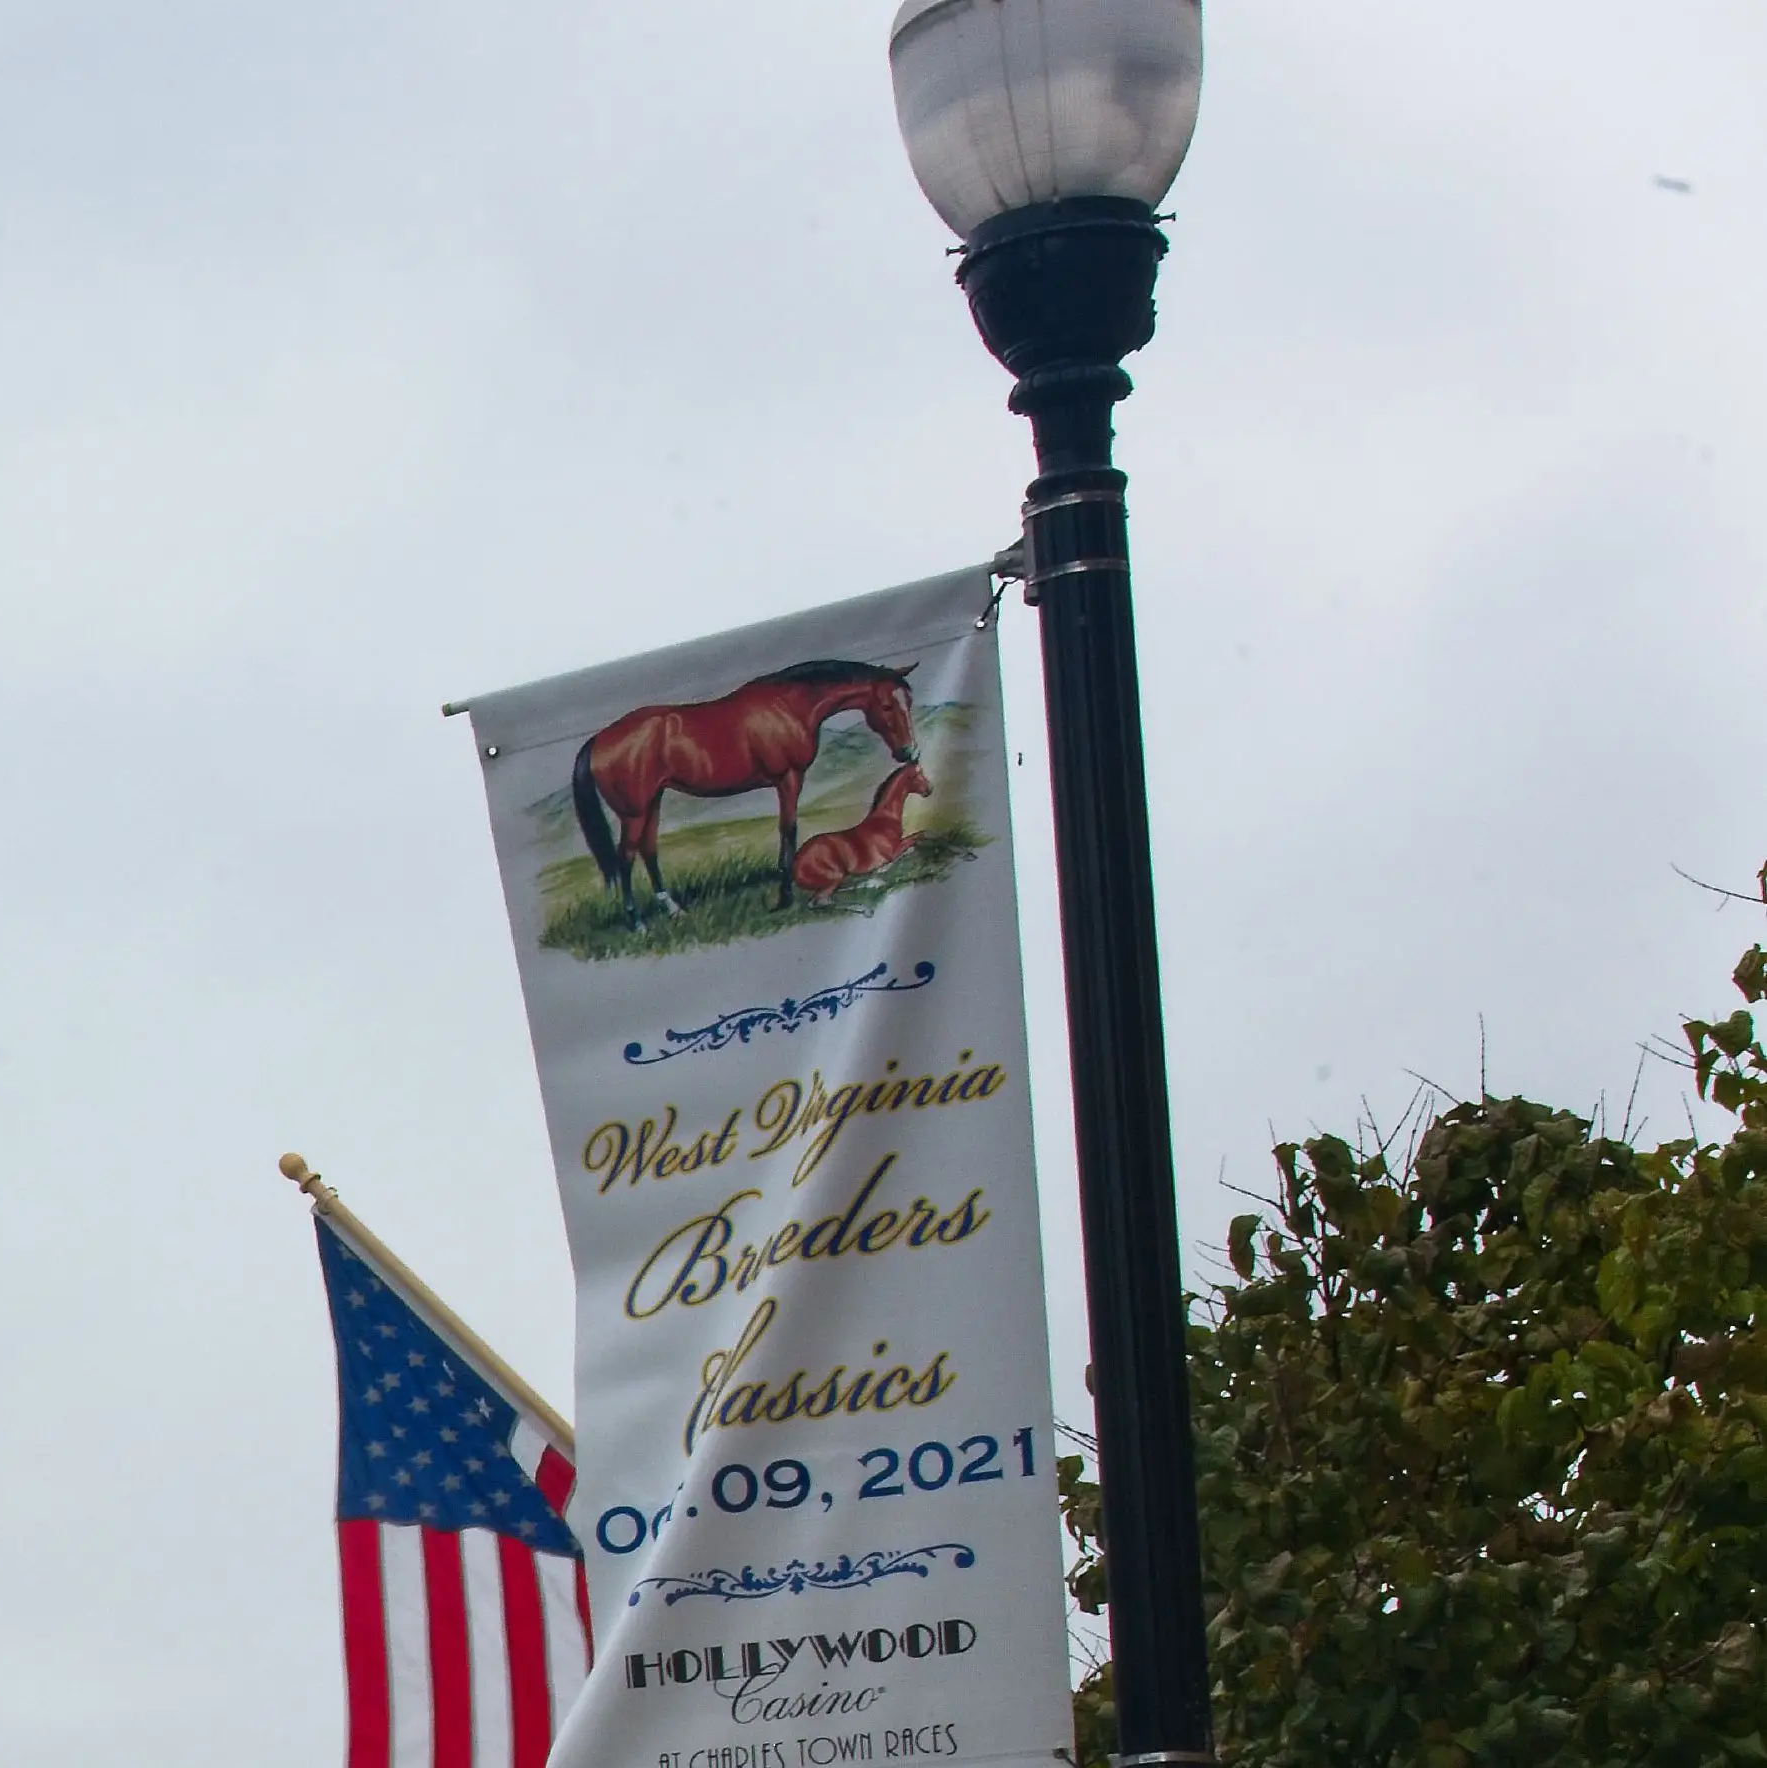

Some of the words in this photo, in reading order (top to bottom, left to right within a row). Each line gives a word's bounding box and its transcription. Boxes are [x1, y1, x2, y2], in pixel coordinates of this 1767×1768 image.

[583, 1105, 744, 1195] West
[711, 1458, 833, 1513] 09,
[857, 1426, 1036, 1500] 2021
[625, 1618, 978, 1690] HOLLYWOOD
[798, 1732, 873, 1767] TOWN
[884, 1723, 959, 1758] RACES
